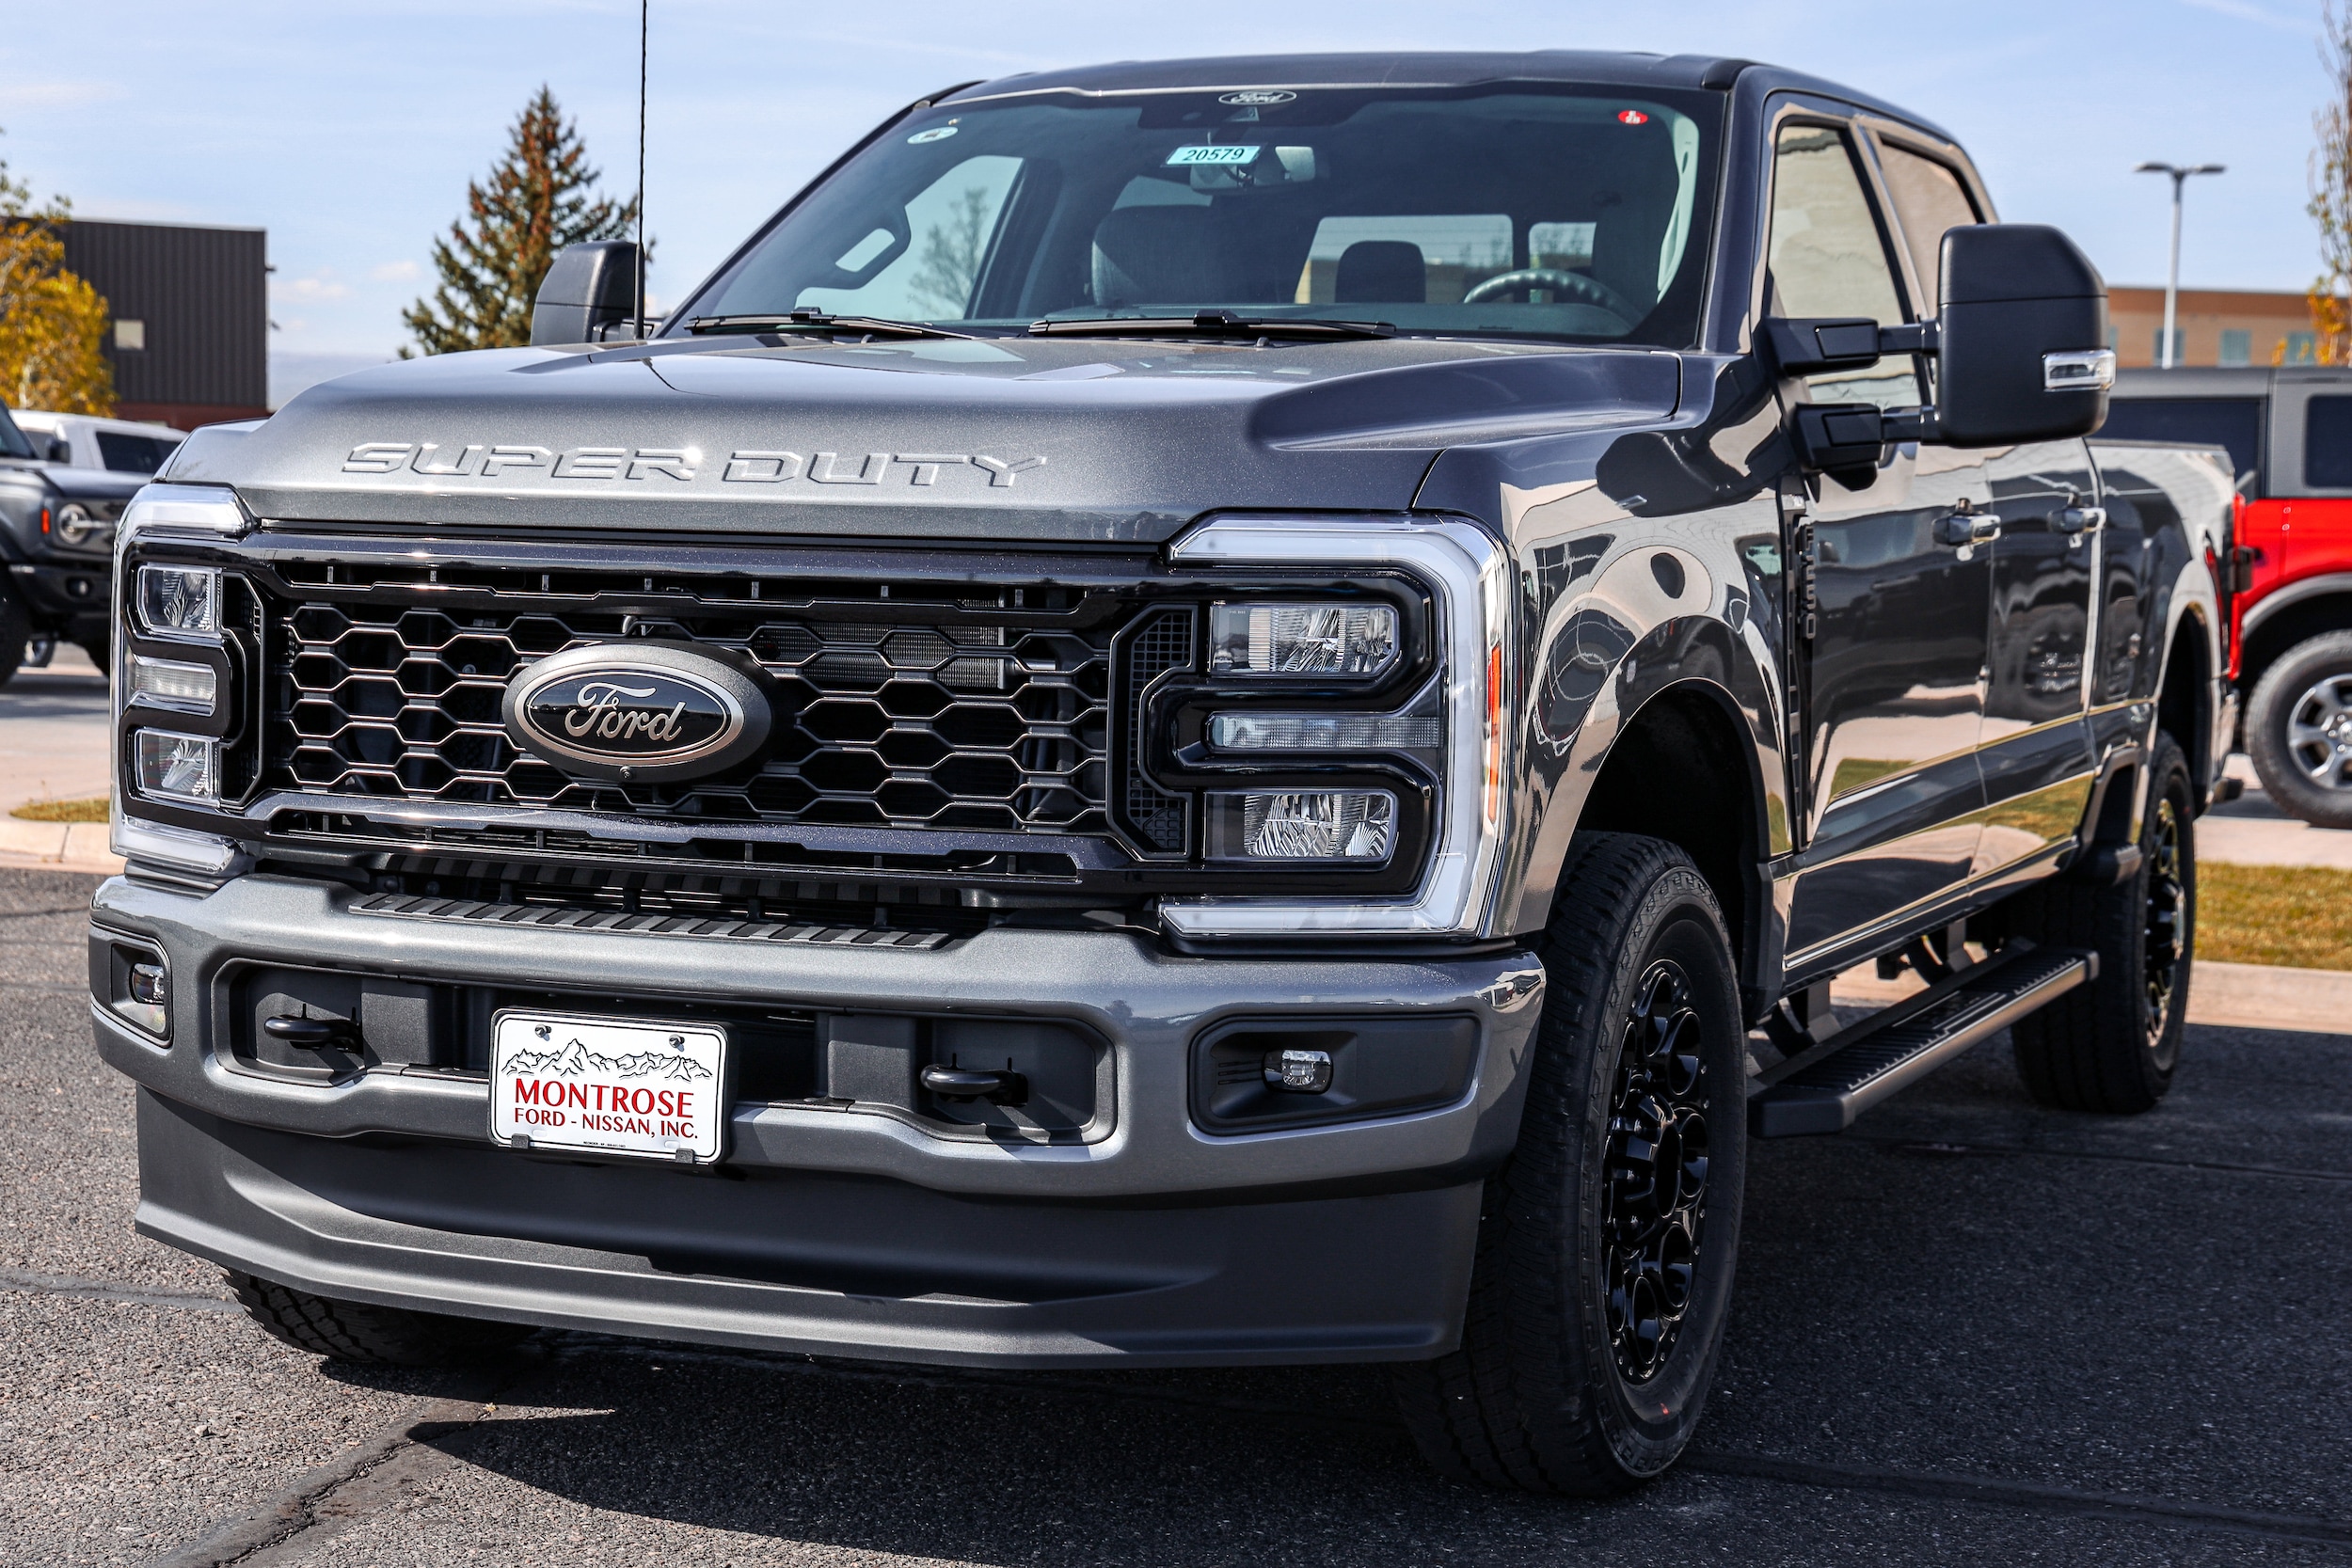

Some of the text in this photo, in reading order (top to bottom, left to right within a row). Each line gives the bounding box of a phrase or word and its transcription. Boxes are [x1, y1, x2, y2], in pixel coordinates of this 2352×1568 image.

[1231, 91, 1284, 103] Ford
[1184, 148, 1245, 162] 20579
[341, 441, 1048, 488] SUPER DUTY
[564, 682, 686, 743] Ford
[515, 1078, 694, 1118] MONTROSE
[515, 1107, 565, 1127] FORD
[582, 1113, 656, 1138] NISSAN,
[660, 1120, 698, 1139] INC.
